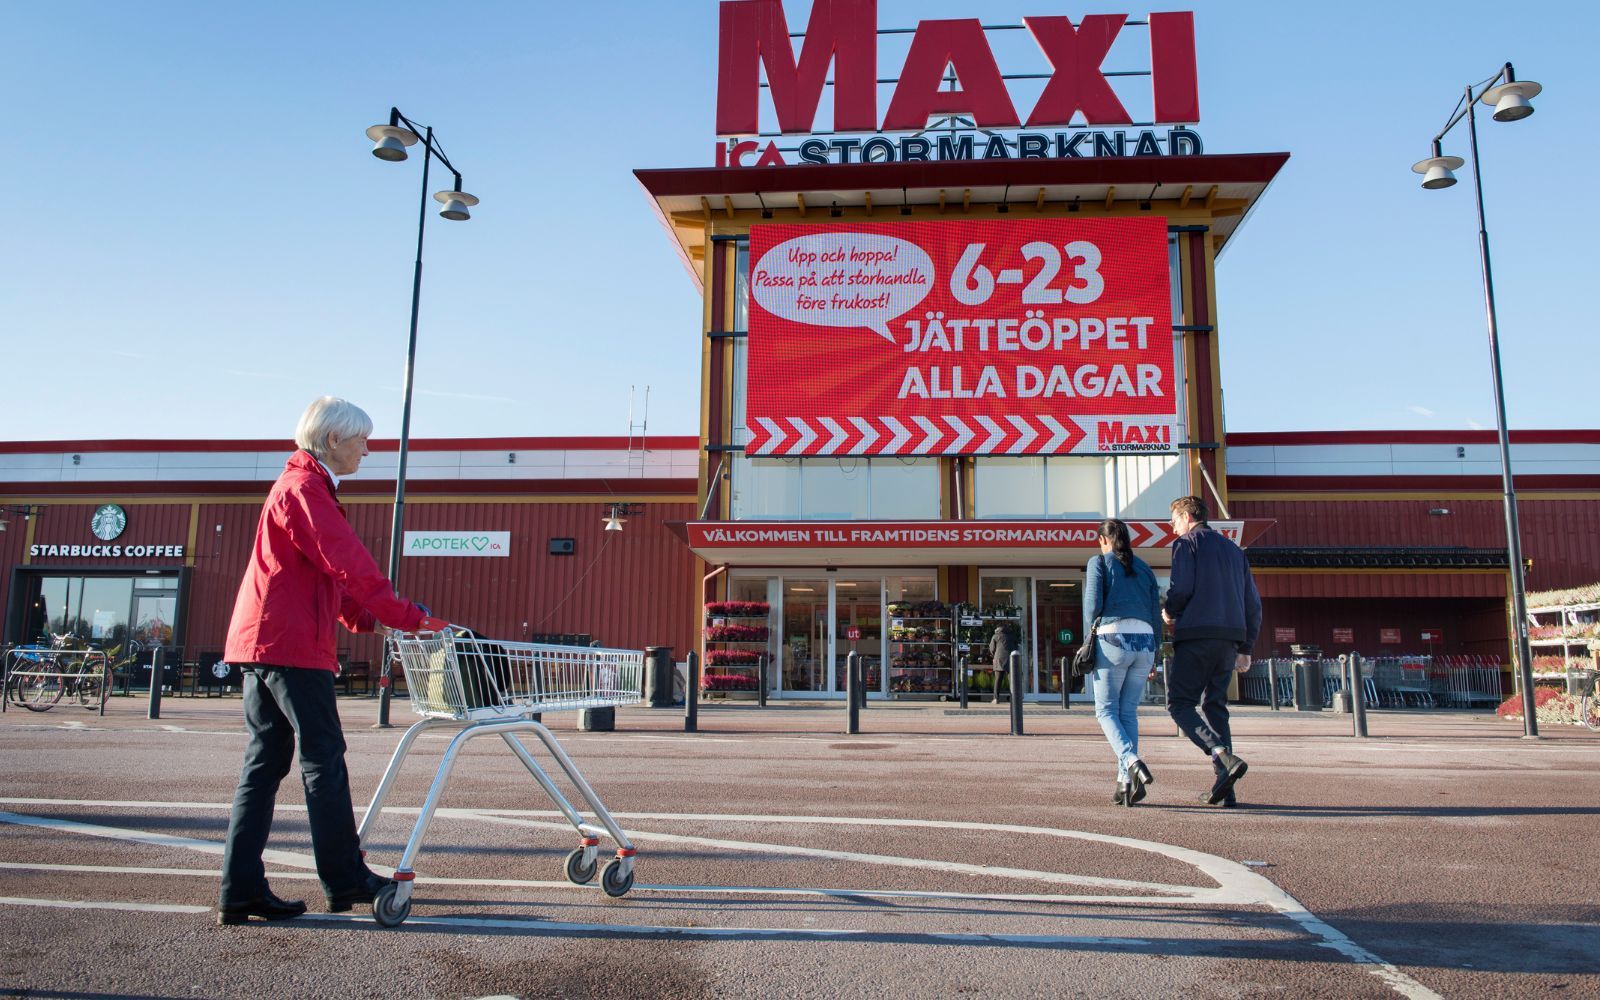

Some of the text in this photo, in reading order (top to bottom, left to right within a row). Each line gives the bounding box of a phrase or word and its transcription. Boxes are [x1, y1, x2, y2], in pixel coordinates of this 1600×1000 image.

[716, 0, 1200, 137] MAXI
[715, 129, 1204, 167] ICA STORMARKNAD
[788, 245, 898, 267] Upp och hoppa!
[755, 267, 926, 290] Passa på att storhandla
[949, 240, 1105, 306] 6-23
[796, 292, 890, 310] före frukost!
[903, 310, 1154, 353] JÄTTEÖPPET
[897, 364, 1164, 399] ALLA DAGAR
[1098, 421, 1170, 443] MAXI
[1112, 443, 1171, 451] STORMARKNAD
[411, 538, 469, 550] APOTEK
[703, 529, 1098, 542] VÄLKOMMEN TILL FRAMTIDENS STORMARKNAD
[30, 545, 183, 557] STARBUCKS COFFEE
[848, 630, 860, 639] ut
[1061, 631, 1071, 640] in
